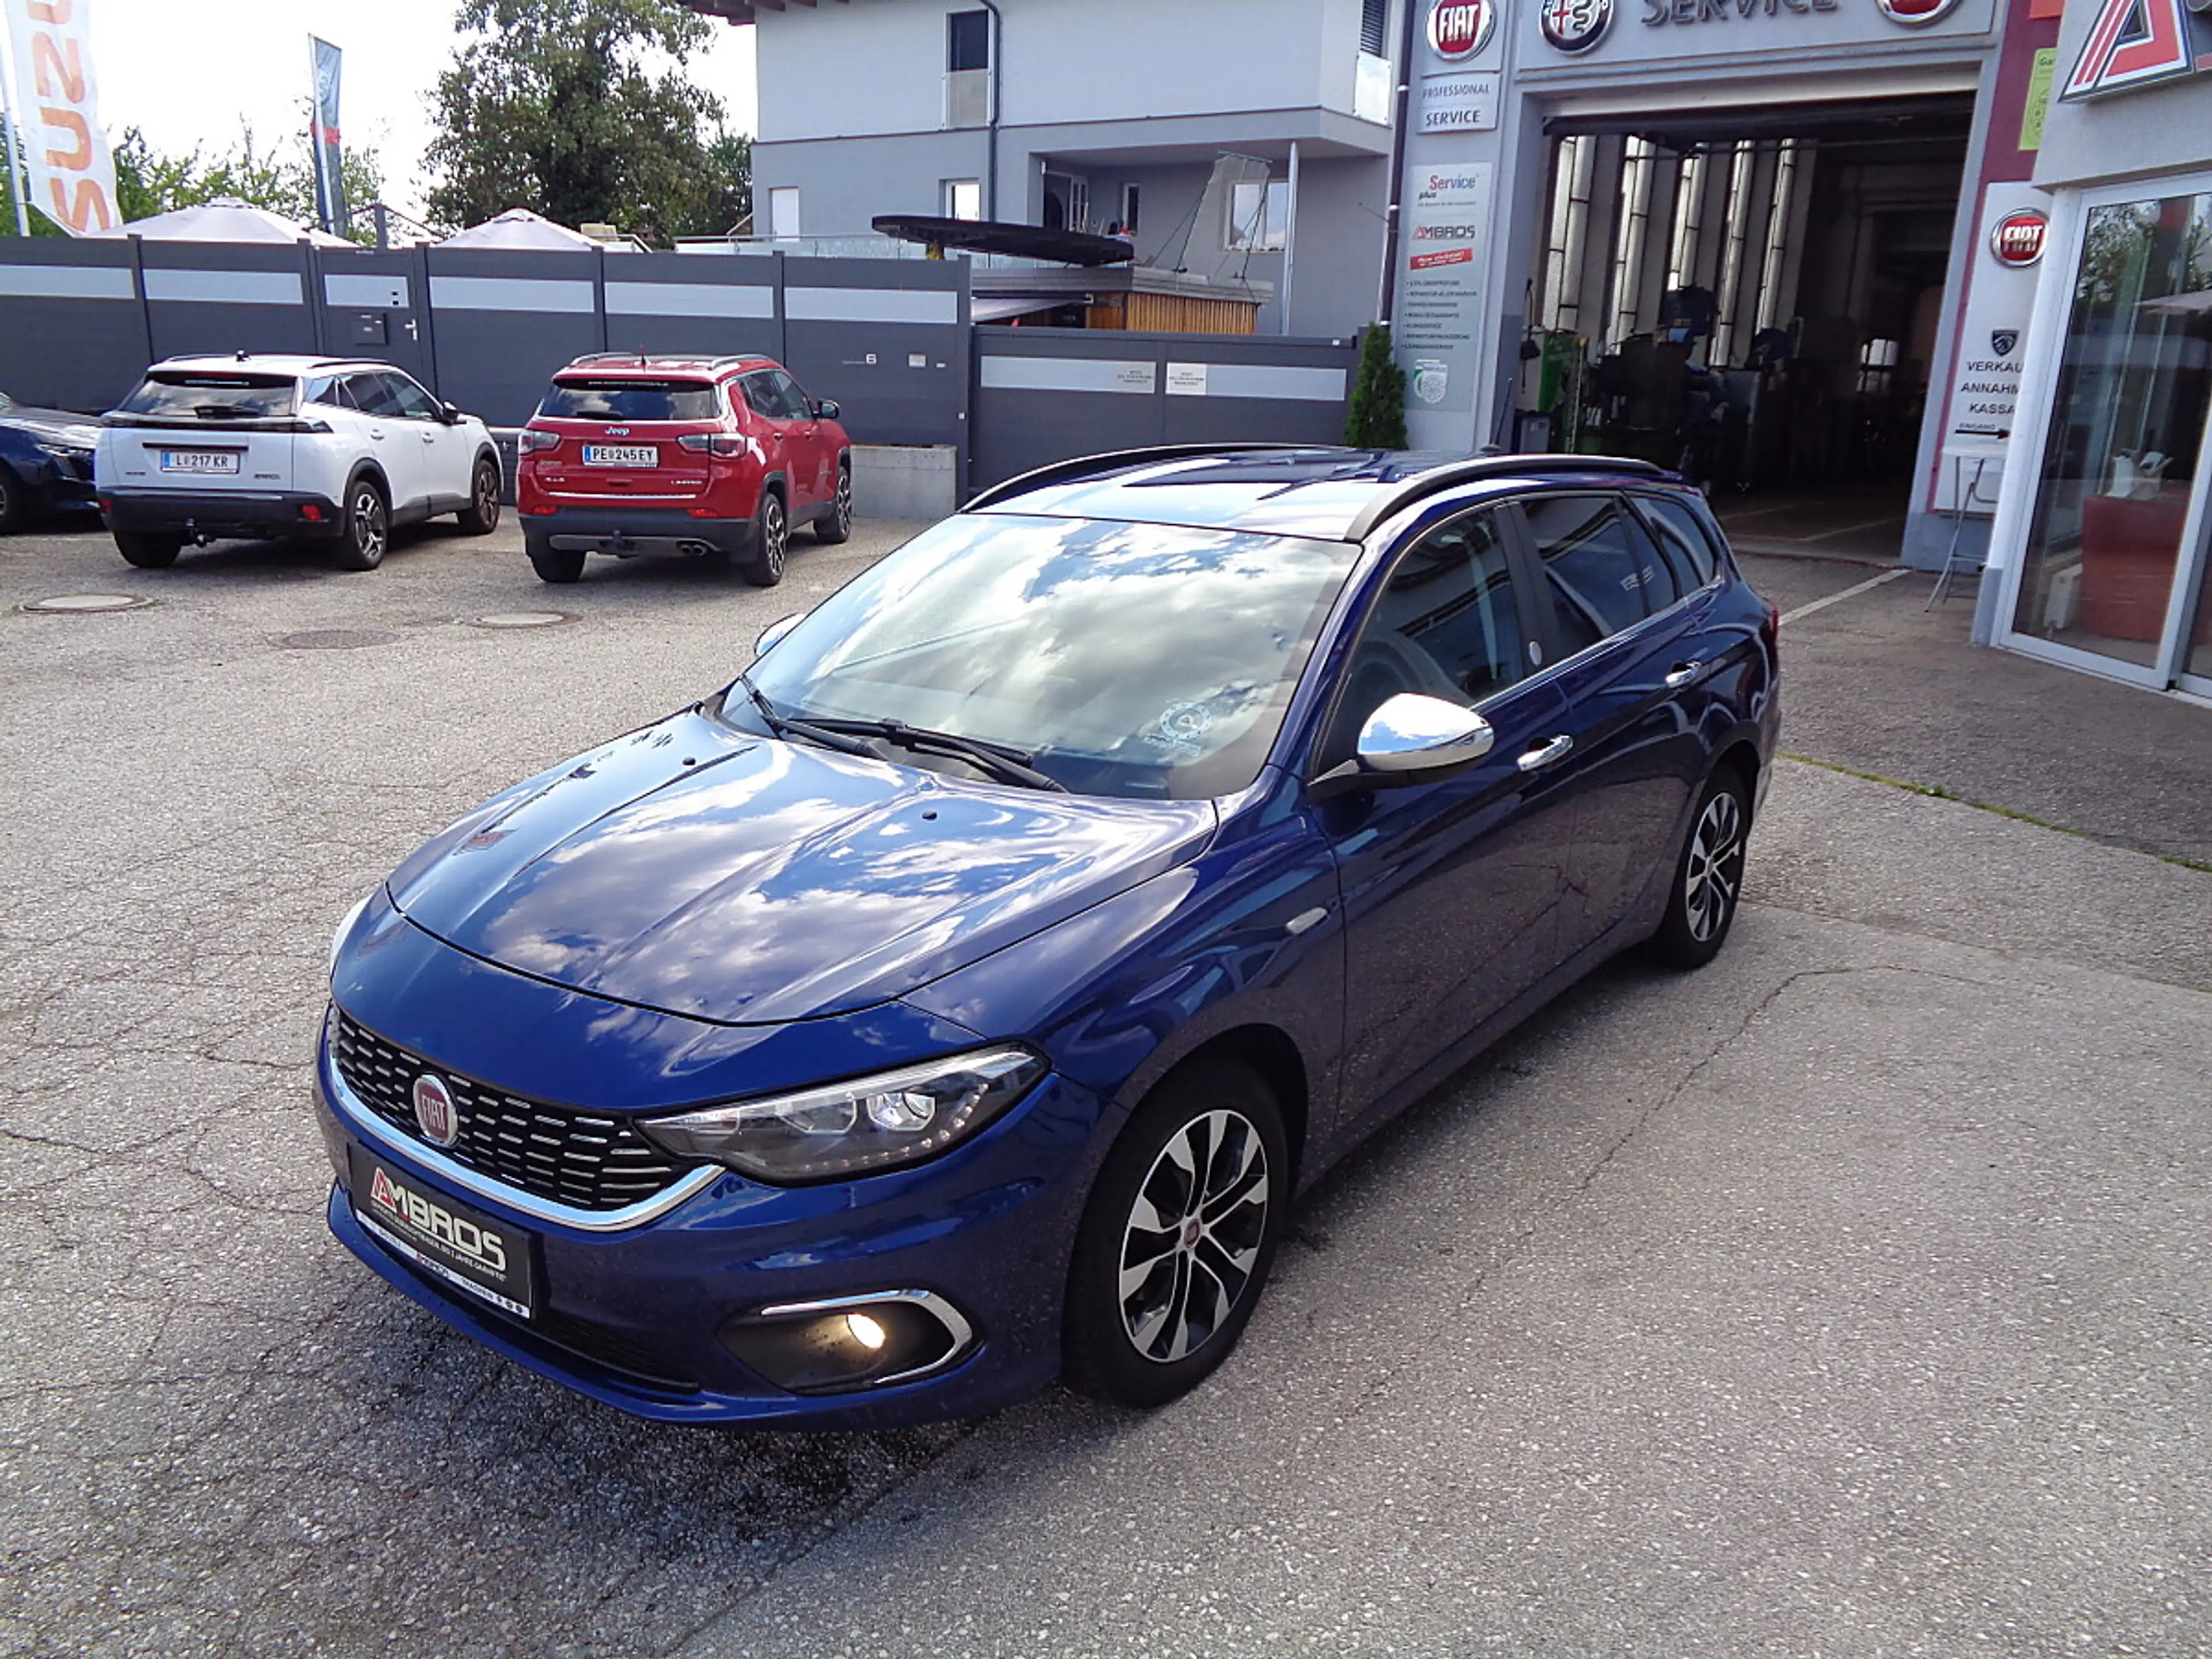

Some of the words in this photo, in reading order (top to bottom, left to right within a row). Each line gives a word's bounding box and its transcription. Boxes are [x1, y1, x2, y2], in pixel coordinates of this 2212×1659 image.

[1440, 3, 1480, 43] FIAT
[1423, 84, 1490, 99] PROFESSIONAL
[1426, 109, 1480, 126] SERVICE
[1429, 174, 1476, 190] Service
[1413, 225, 1476, 240] AMBROS
[2004, 225, 2043, 252] FIAT
[1967, 361, 2023, 373] VERKAU
[1969, 403, 2016, 414] KASSA
[604, 426, 630, 436] Jeep
[176, 454, 181, 465] L
[191, 454, 211, 467] 217
[214, 455, 228, 467] KR
[593, 448, 607, 460] PE
[615, 448, 637, 460] 245
[639, 449, 654, 460] EY
[421, 1093, 445, 1132] FIAT
[370, 1166, 507, 1272] AMBROS
